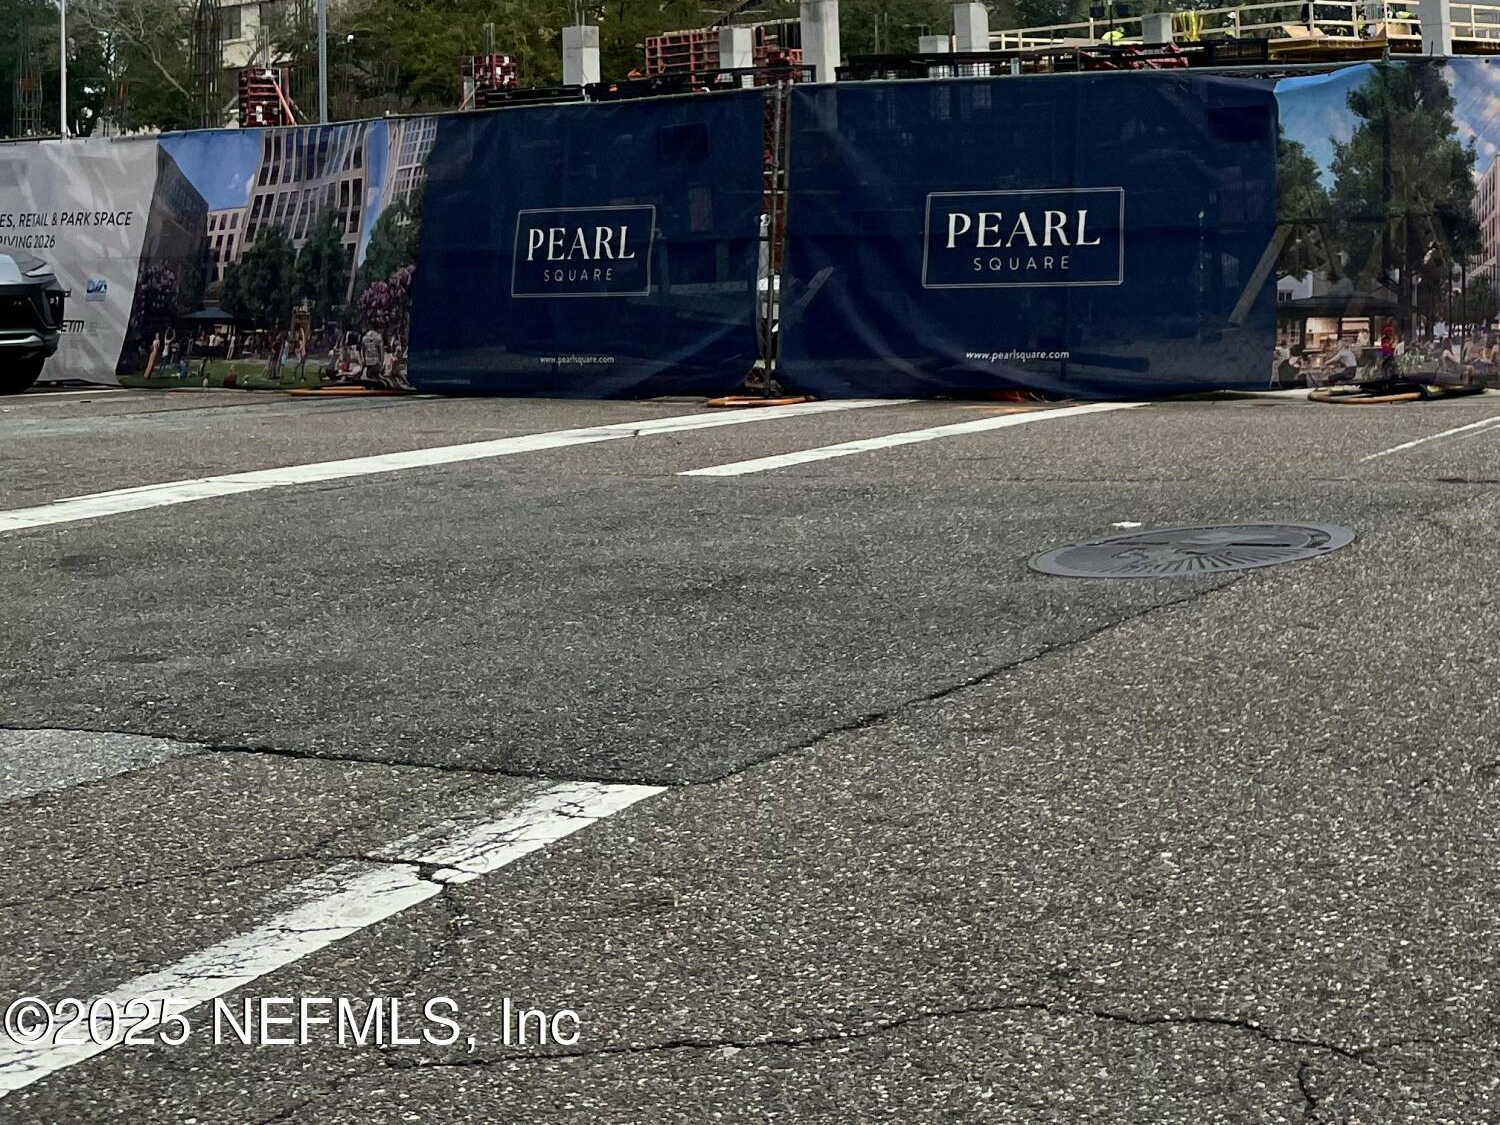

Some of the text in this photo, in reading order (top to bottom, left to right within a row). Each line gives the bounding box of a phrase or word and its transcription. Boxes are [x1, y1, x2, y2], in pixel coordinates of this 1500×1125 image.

[19, 212, 49, 227] RETAIL
[51, 212, 58, 226] &
[60, 212, 92, 227] PARK
[93, 211, 133, 226] SPACE
[946, 209, 1101, 249] PEARL
[33, 235, 56, 248] 2026
[526, 225, 636, 261] PEARL
[973, 255, 1070, 271] SQUARE
[543, 268, 614, 282] SQUARE
[539, 355, 615, 366] www.pearlsquare.com
[965, 349, 1070, 363] www.pearlsquare.com
